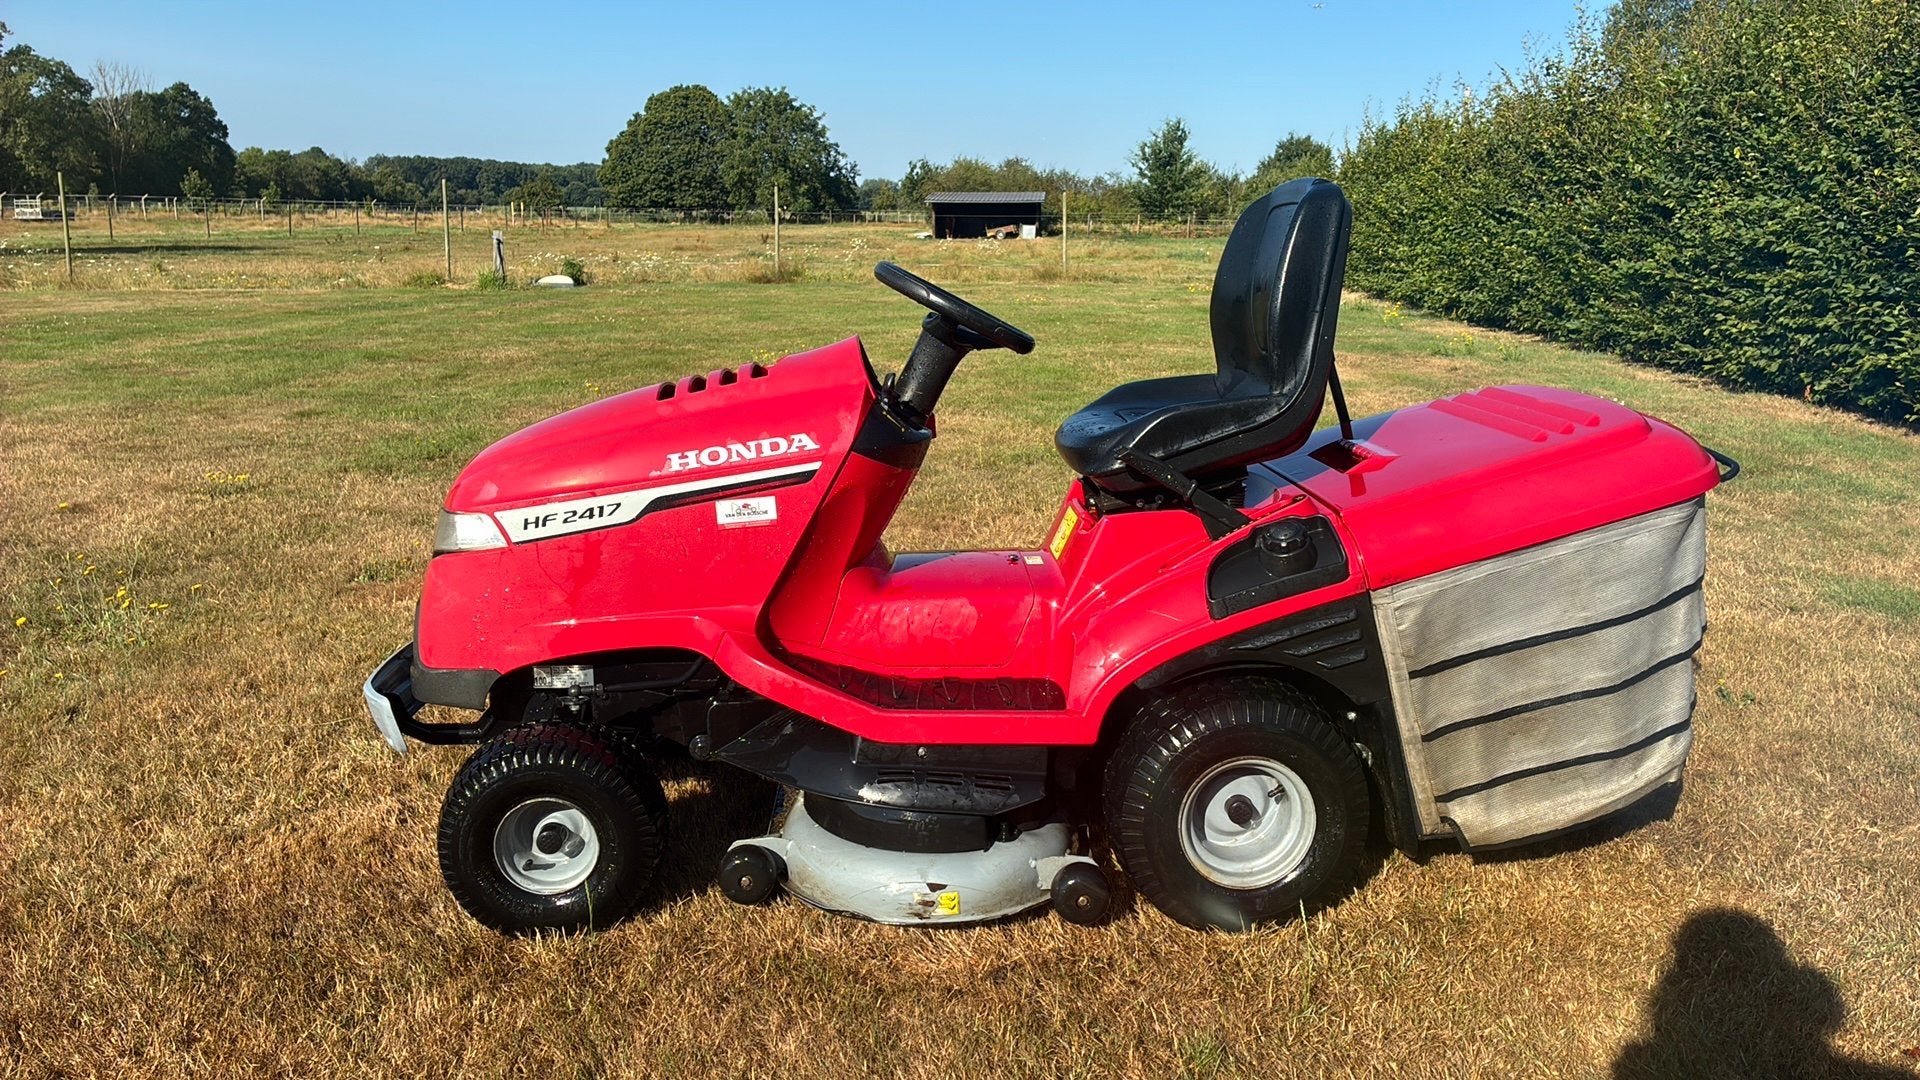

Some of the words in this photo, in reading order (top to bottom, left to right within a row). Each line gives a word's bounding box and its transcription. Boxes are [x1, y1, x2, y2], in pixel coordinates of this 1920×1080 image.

[667, 433, 820, 472] HONDA
[523, 513, 558, 531] HF
[562, 502, 622, 524] 2417
